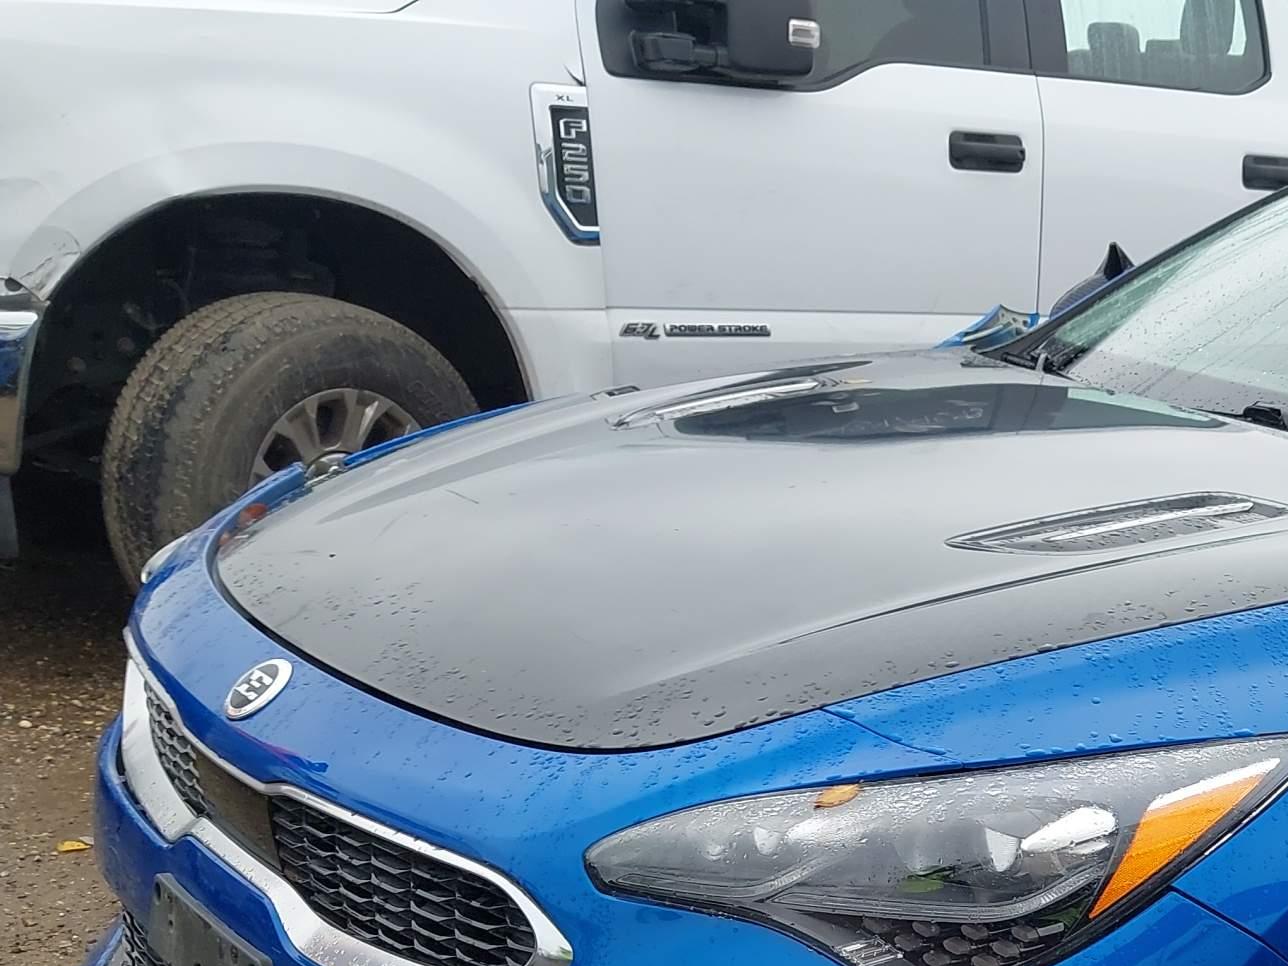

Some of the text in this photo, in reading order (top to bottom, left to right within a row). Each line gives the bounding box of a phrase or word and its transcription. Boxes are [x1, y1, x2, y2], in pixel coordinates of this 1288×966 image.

[555, 94, 574, 102] XL
[559, 118, 591, 204] F250
[669, 323, 715, 333] POWER
[717, 324, 769, 334] STROKE
